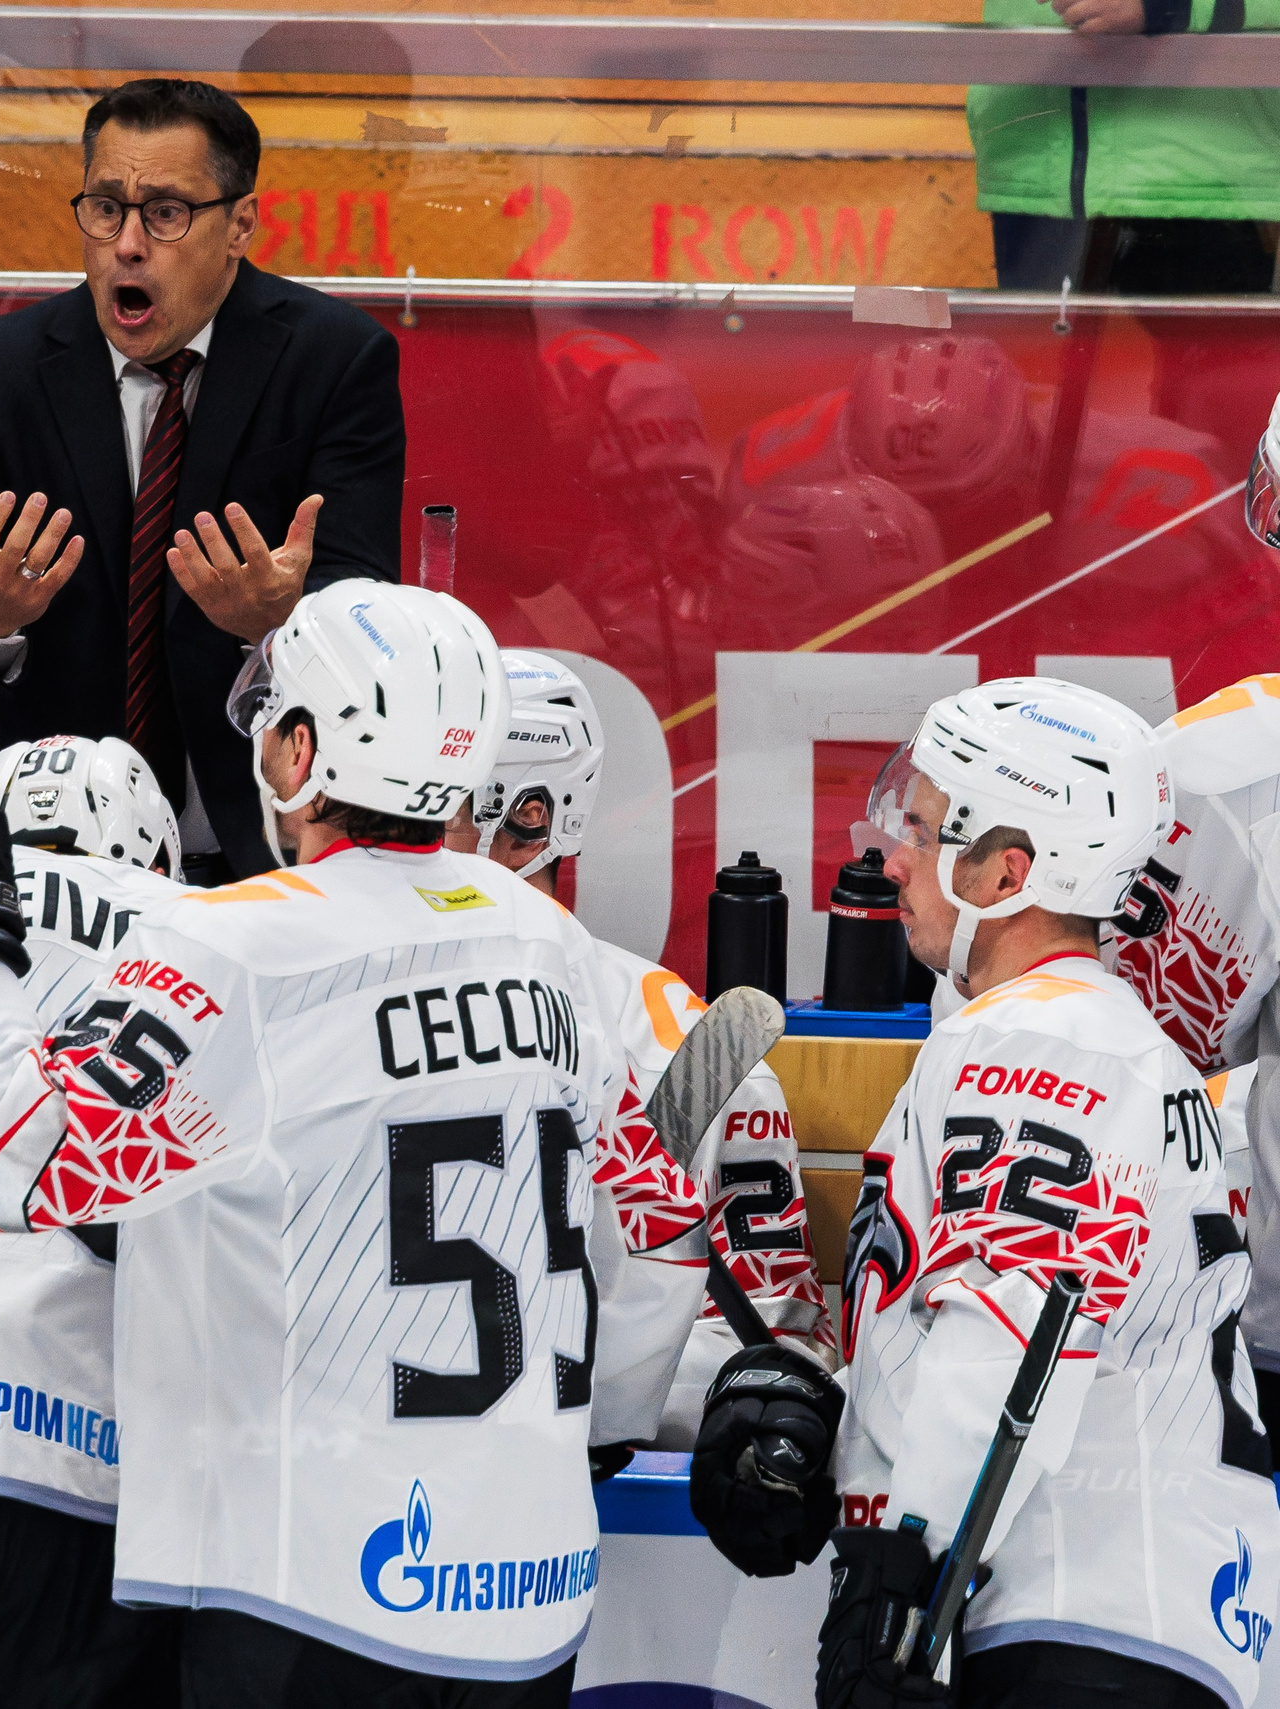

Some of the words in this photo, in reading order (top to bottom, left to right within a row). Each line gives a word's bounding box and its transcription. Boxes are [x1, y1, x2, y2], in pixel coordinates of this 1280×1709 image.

[256, 190, 396, 278] ЯД
[503, 183, 575, 280] 2
[652, 203, 896, 282] ROW
[439, 743, 472, 758] BET
[444, 727, 476, 743] FON
[506, 730, 561, 745] BAUER
[18, 747, 77, 779] 90
[995, 765, 1060, 800] BAUER
[405, 780, 471, 817] 55
[443, 890, 486, 906] БАНК
[108, 959, 224, 1022] FONBET
[51, 999, 193, 1112] 55
[375, 978, 583, 1081] CECCONI
[954, 1063, 1108, 1117] FONBET
[724, 1110, 795, 1143] FON
[939, 1114, 1095, 1234] 22
[719, 1159, 806, 1254] 2
[386, 1107, 599, 1419] 55
[435, 1542, 601, 1612] ГАЗПРОМНЕФ
